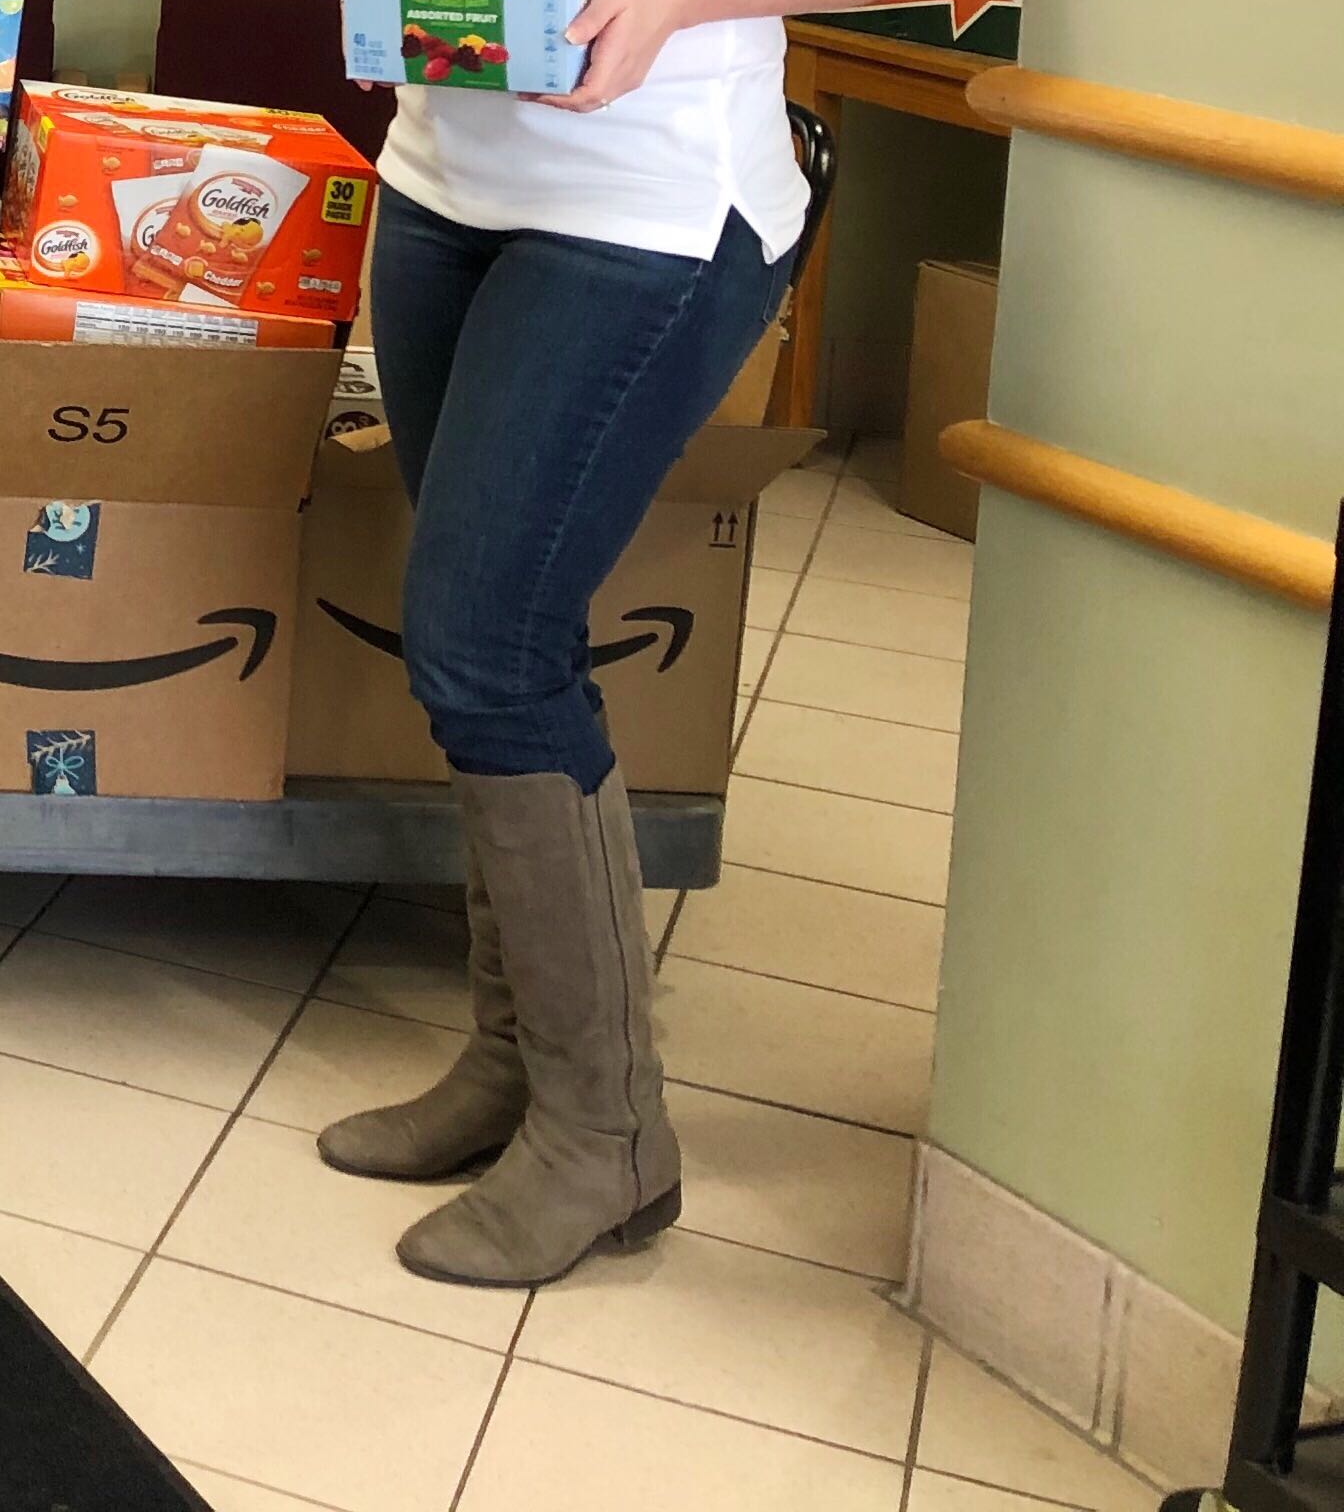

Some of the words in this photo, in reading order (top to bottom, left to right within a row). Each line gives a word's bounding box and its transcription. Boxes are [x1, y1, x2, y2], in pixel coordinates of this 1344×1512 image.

[406, 9, 464, 21] ASSORTED
[465, 13, 498, 24] FRUIT
[63, 89, 136, 105] Goldfish
[330, 180, 355, 202] 30
[201, 188, 270, 219] Goldfish
[41, 237, 89, 256] Goldfish
[203, 271, 244, 287] Cheddar
[46, 405, 131, 444] S5
